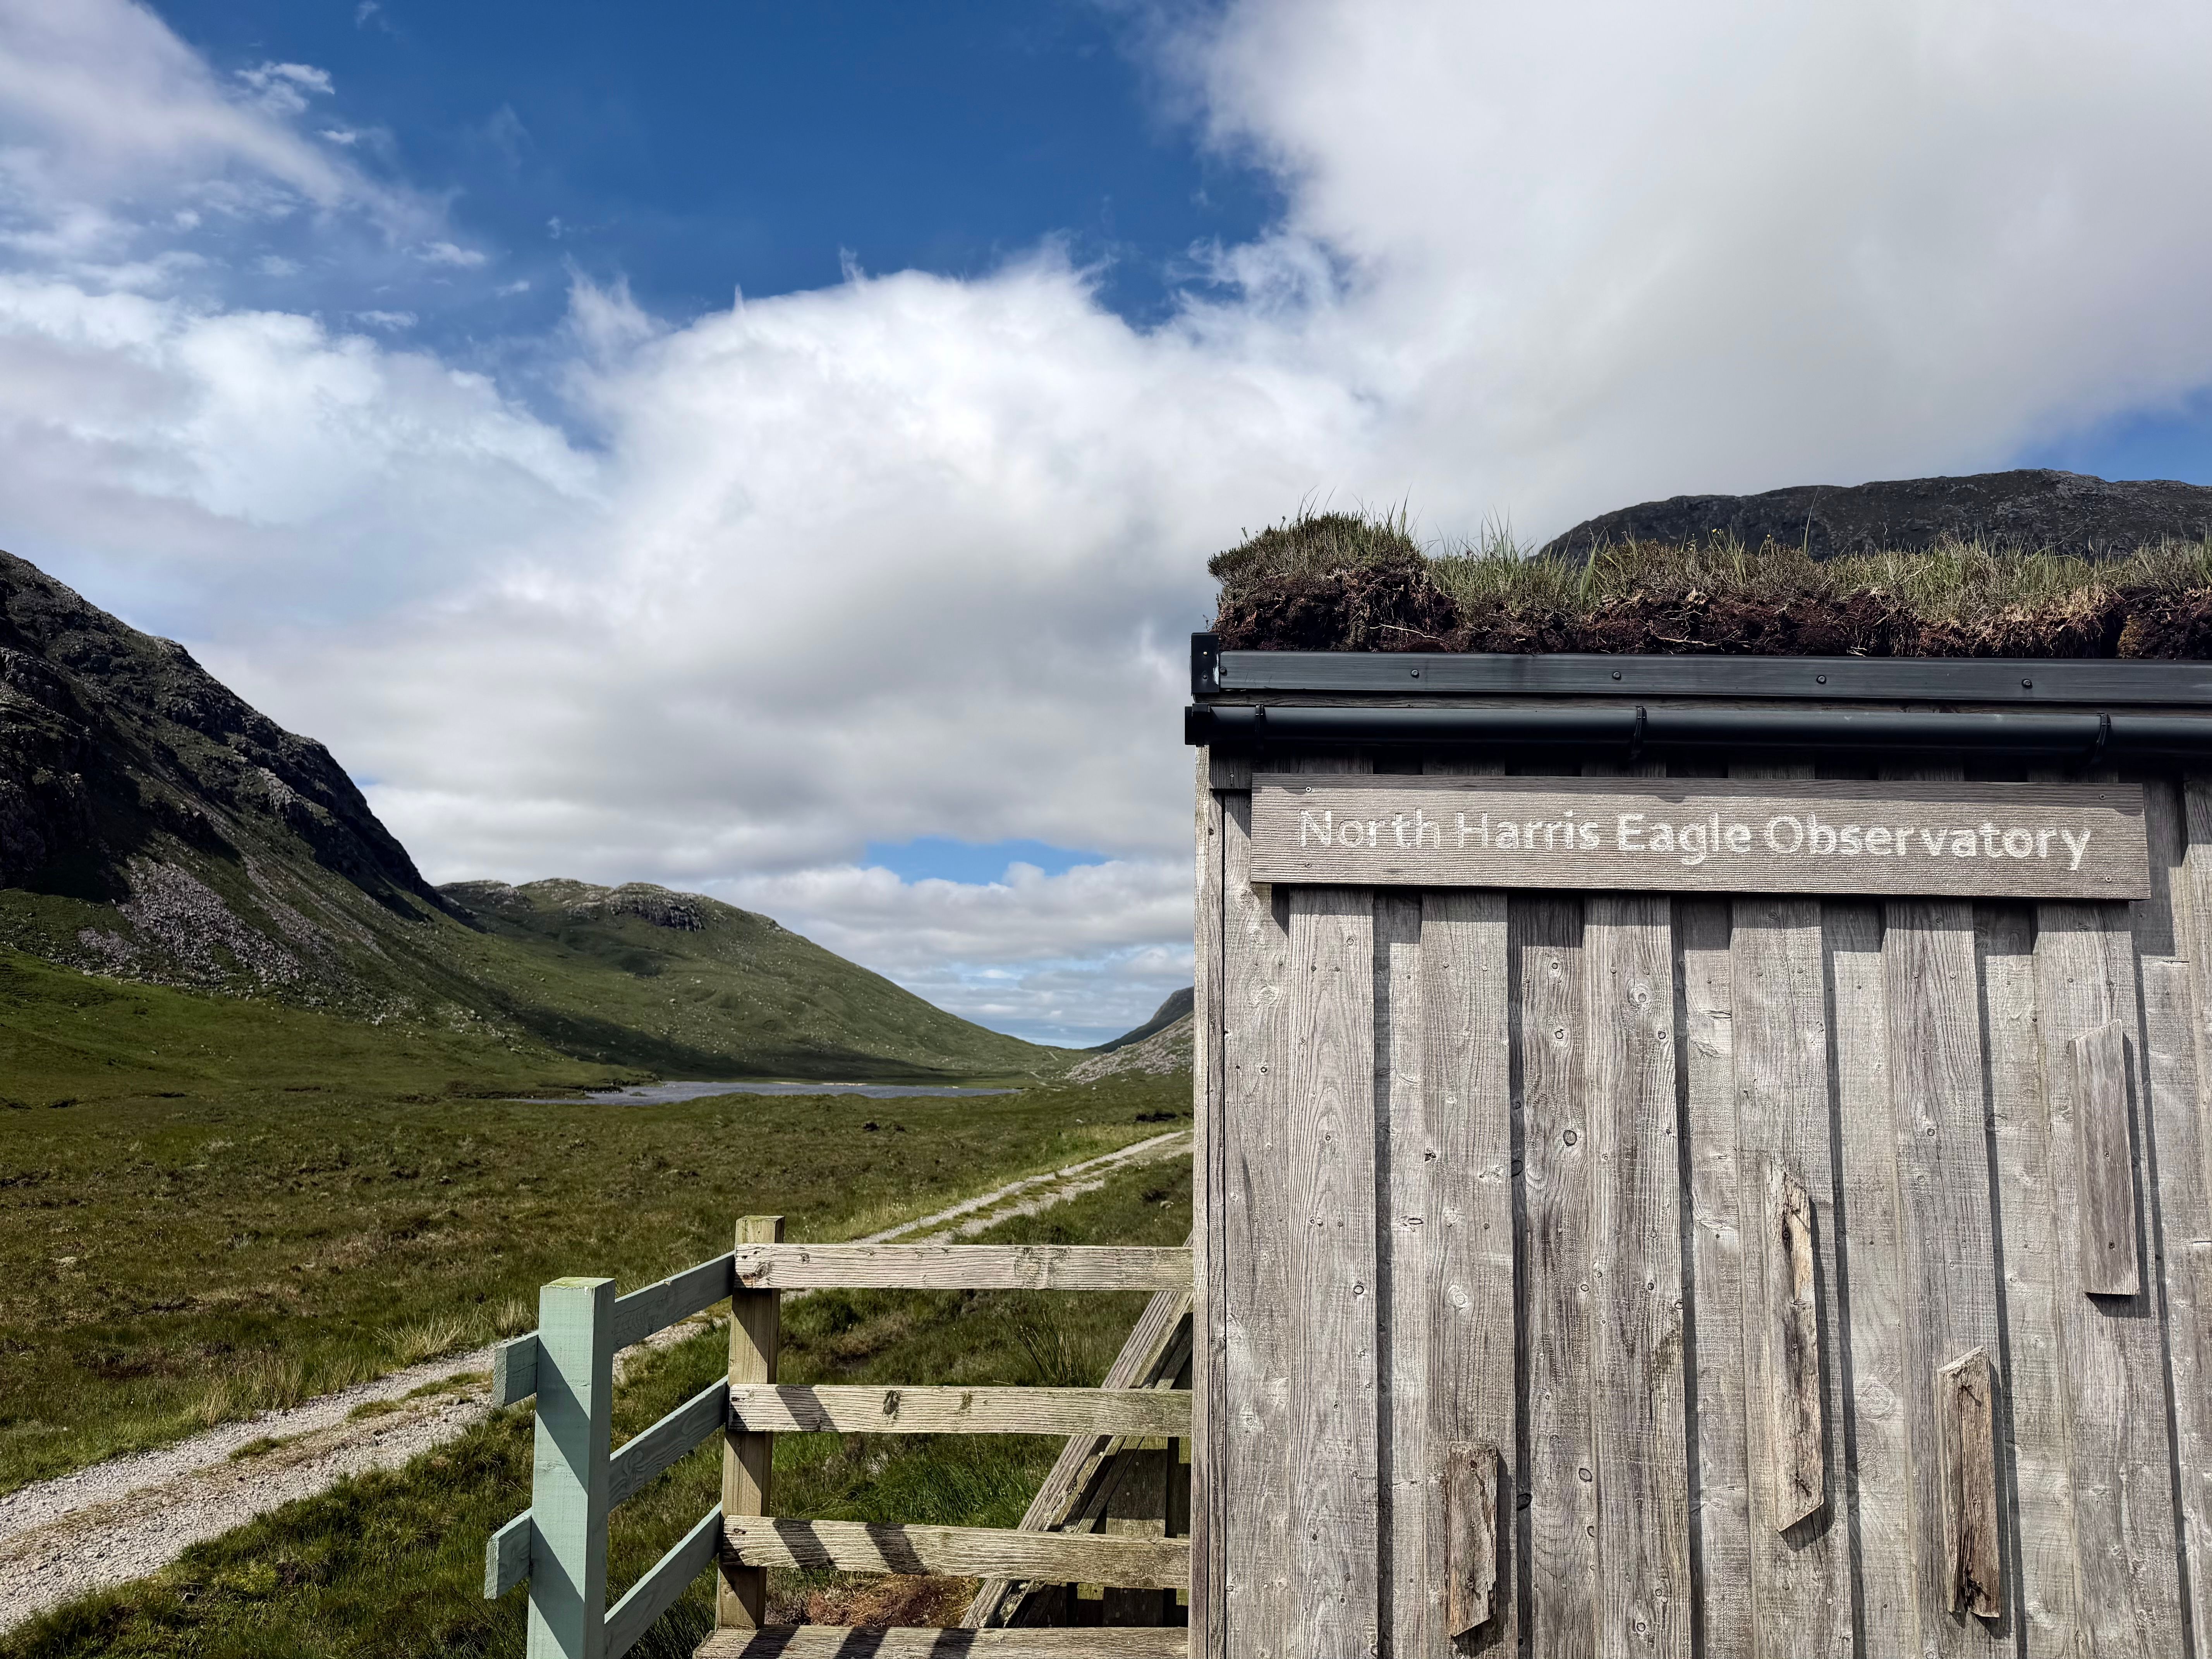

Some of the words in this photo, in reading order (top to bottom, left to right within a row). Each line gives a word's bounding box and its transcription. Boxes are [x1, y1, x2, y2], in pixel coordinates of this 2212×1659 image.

[1299, 807, 1440, 849] North
[1456, 808, 1601, 850] Harris
[1616, 811, 1752, 866] Eagle
[1766, 812, 2091, 871] Observatory
